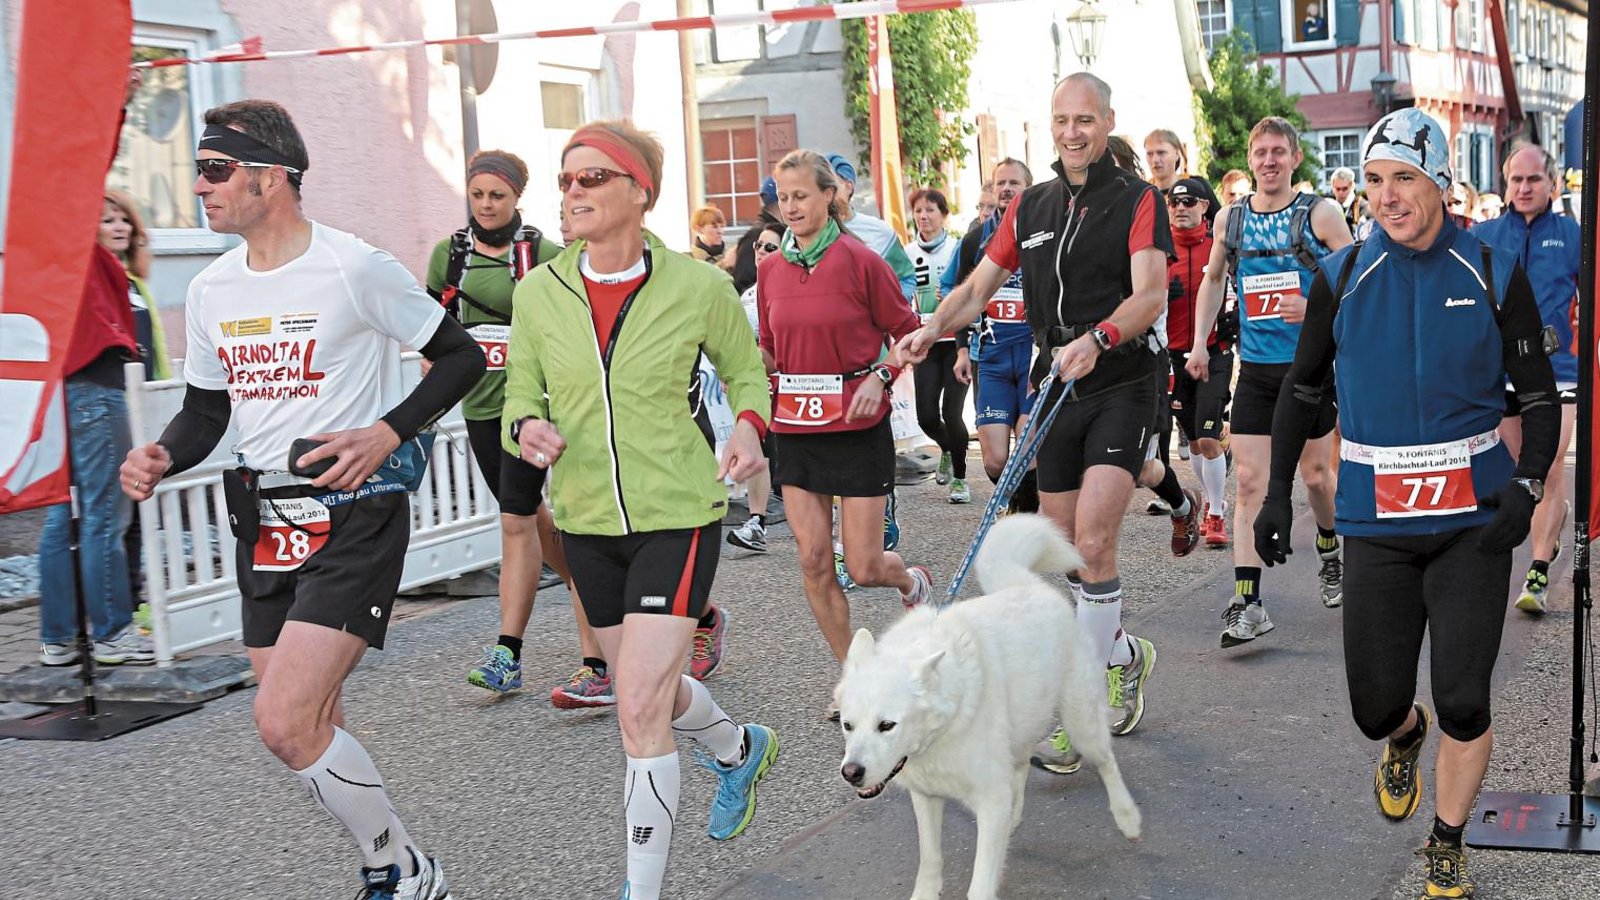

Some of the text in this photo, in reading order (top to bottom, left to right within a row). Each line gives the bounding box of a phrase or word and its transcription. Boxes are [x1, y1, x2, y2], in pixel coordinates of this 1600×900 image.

[996, 302, 1017, 319] 13
[1258, 292, 1284, 314] 72
[236, 366, 300, 384] EXTREM
[794, 396, 824, 418] 78
[1378, 457, 1467, 470] Kirchbachtal-Lauf 2014
[1397, 448, 1447, 459] 9. FONTANIS
[1402, 476, 1447, 507] 77
[271, 530, 310, 562] 28
